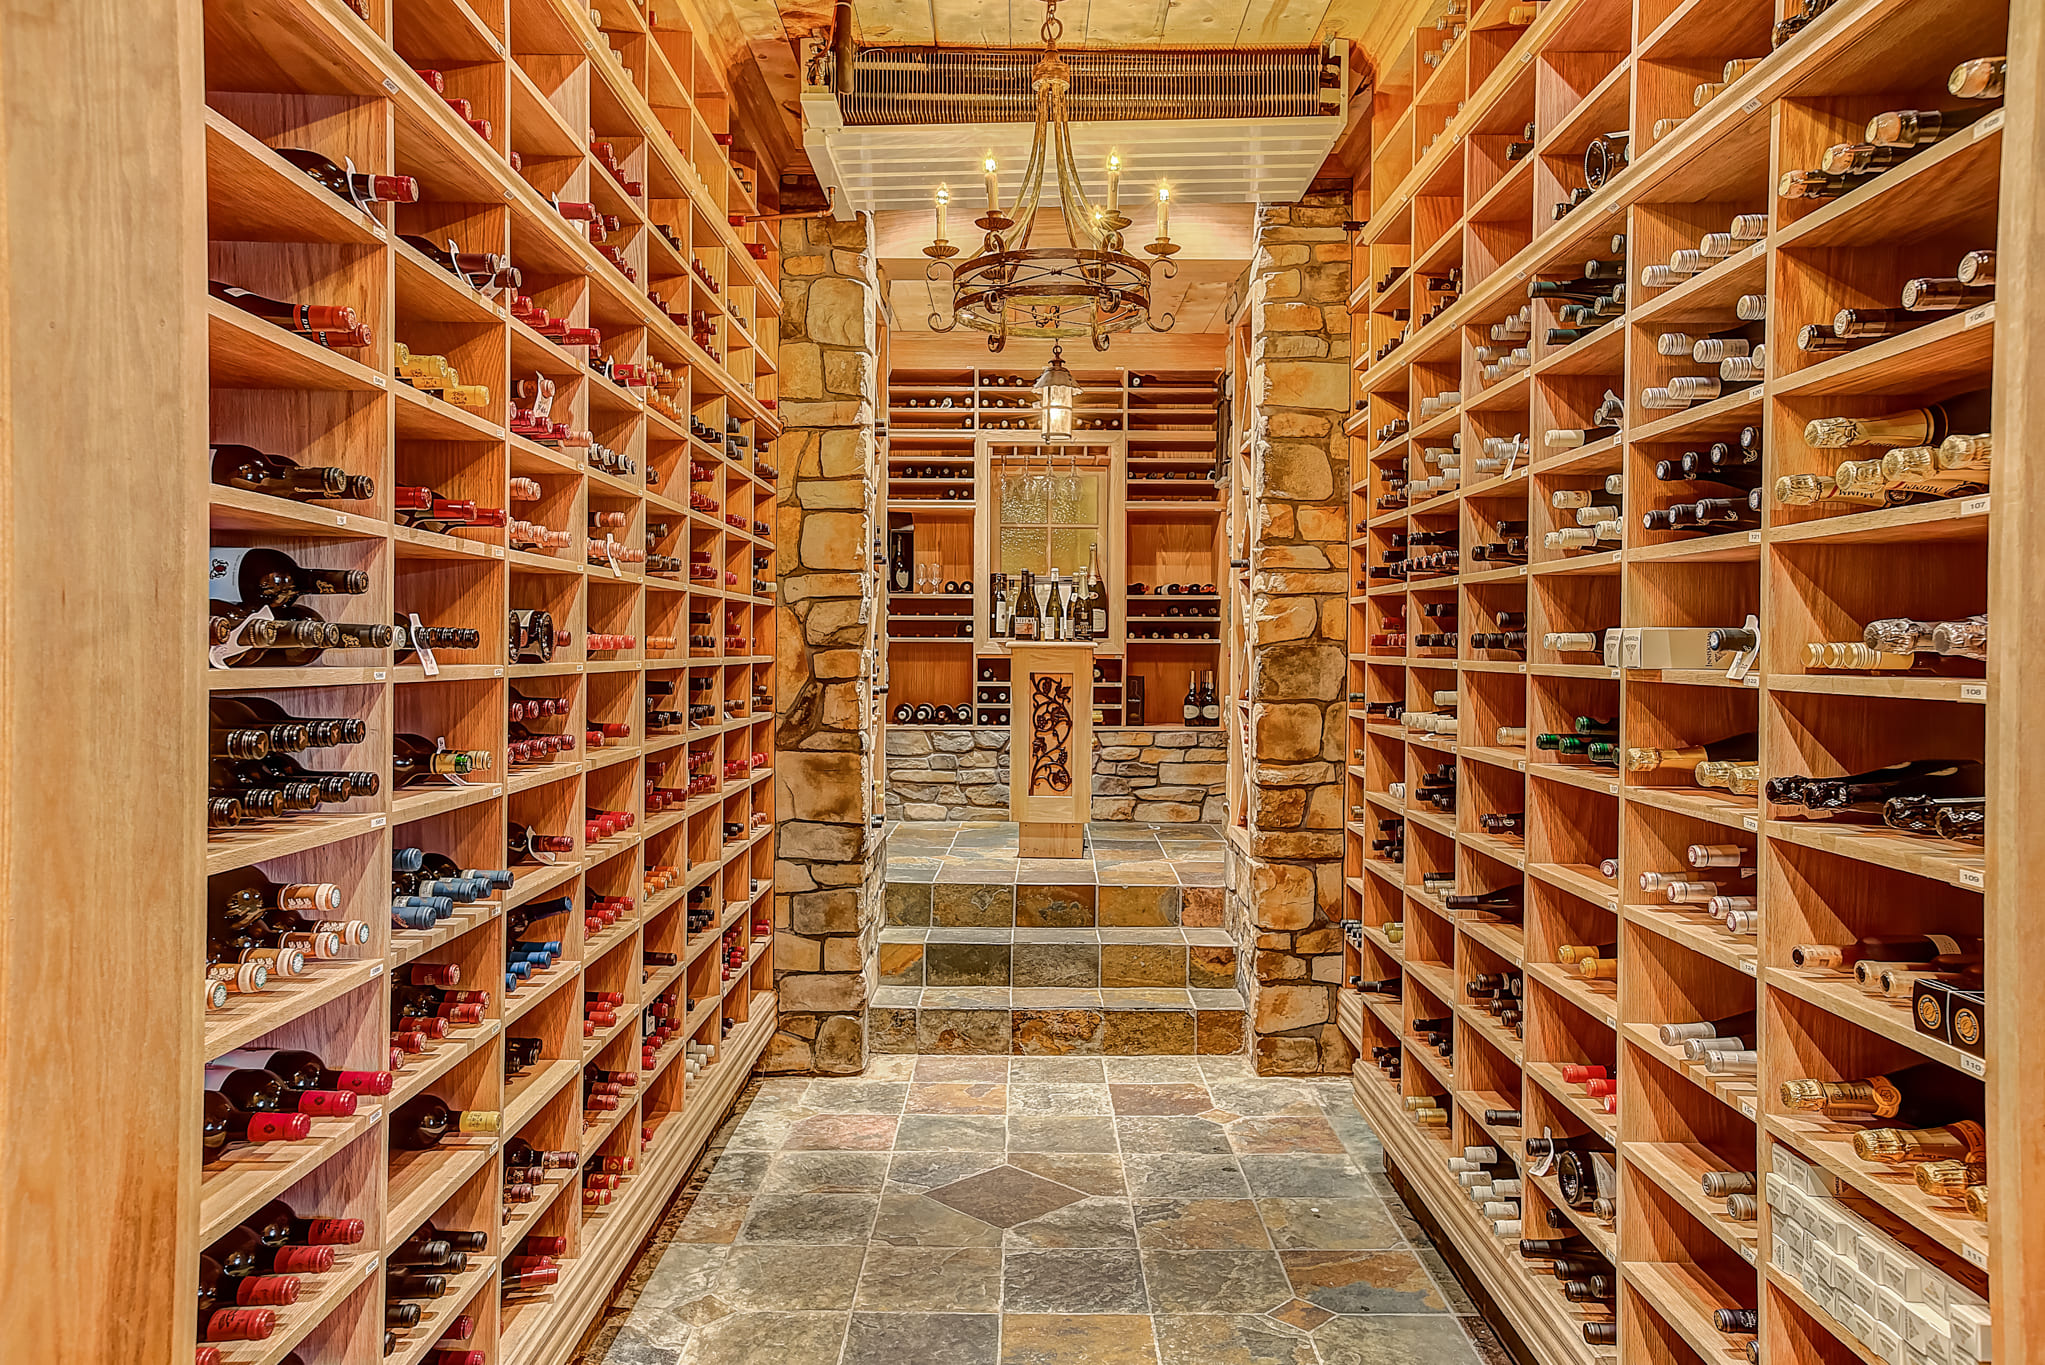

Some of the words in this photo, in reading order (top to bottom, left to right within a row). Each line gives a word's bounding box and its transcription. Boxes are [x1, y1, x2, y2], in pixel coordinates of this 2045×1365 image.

[1970, 501, 1986, 510] 107
[1966, 688, 1981, 696] 108
[1964, 873, 1980, 883] 109
[1965, 1060, 1982, 1071] 110
